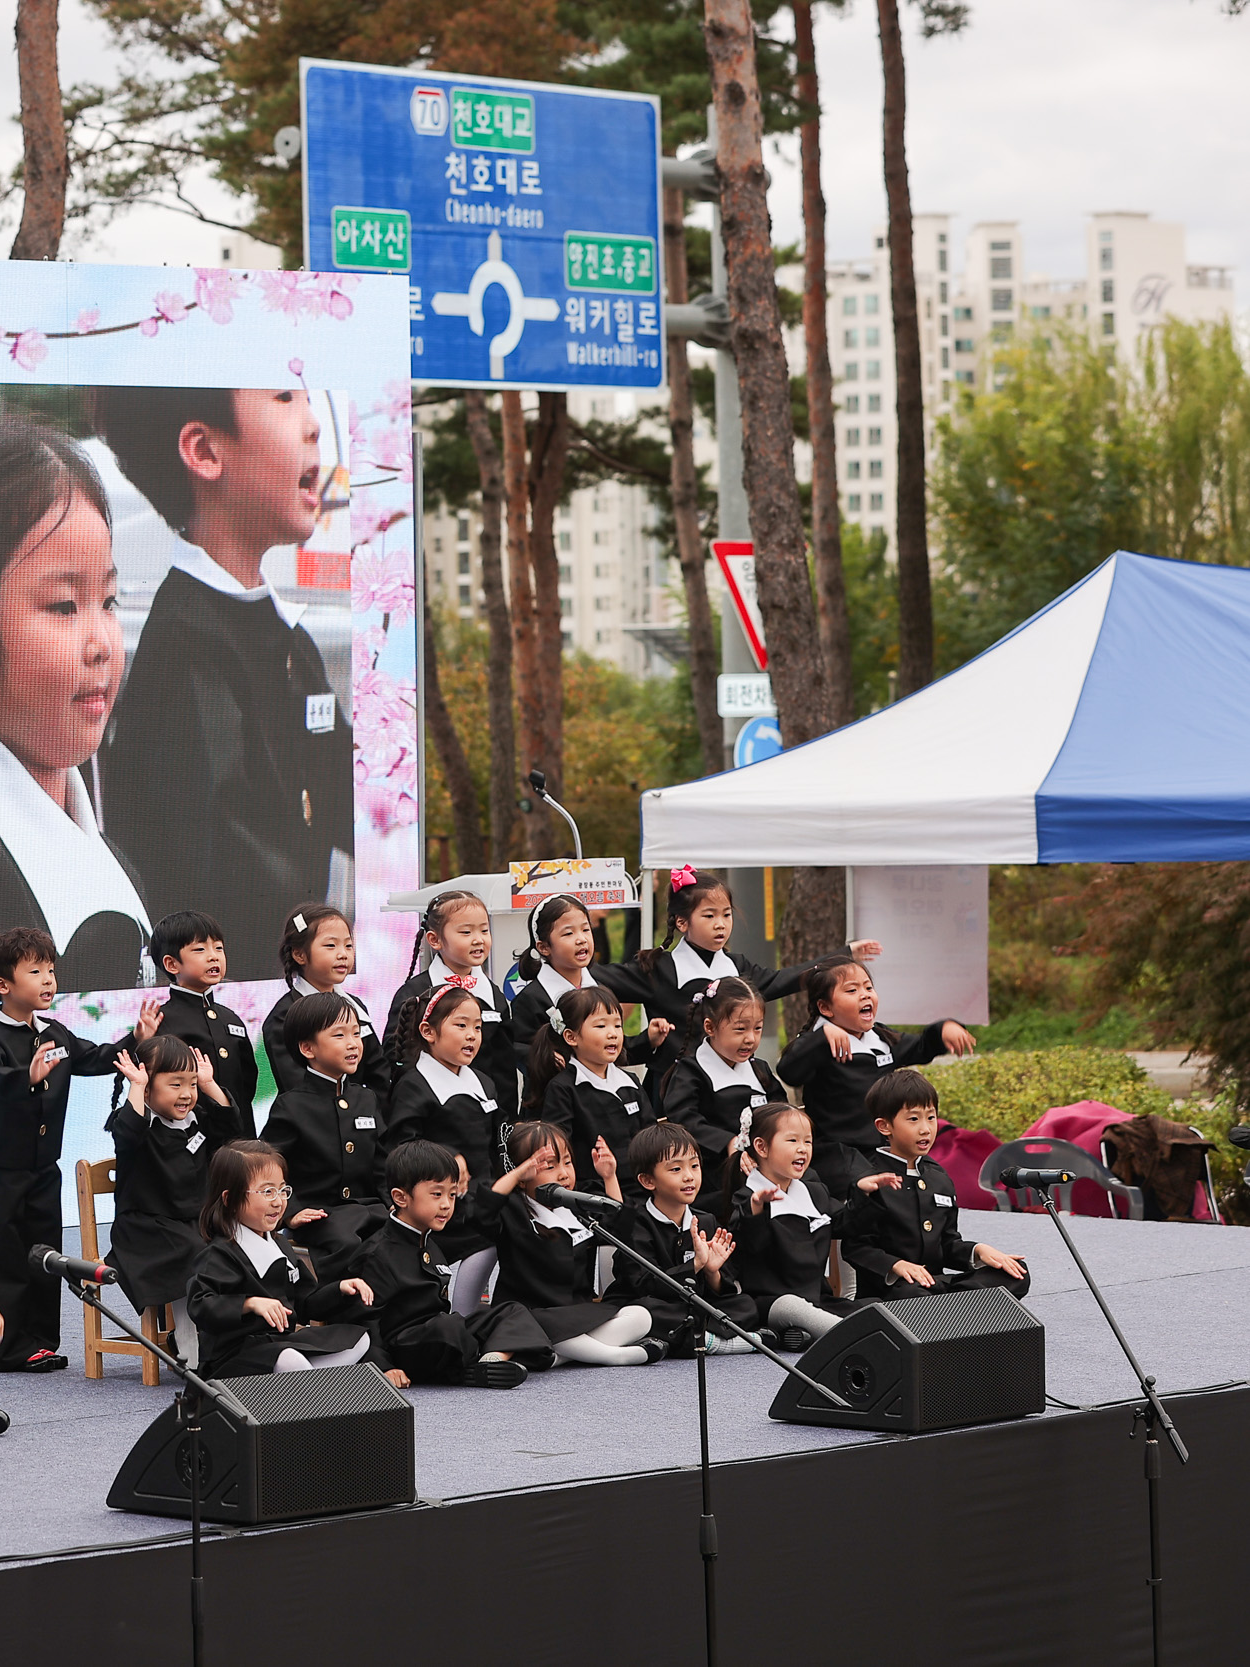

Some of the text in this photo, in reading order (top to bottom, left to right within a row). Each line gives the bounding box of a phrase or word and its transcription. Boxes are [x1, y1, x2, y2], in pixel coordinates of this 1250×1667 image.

[419, 98, 441, 126] 70
[444, 151, 543, 197] 천호대로
[445, 197, 544, 229] Cheonho-daero
[337, 218, 406, 261] 아차산
[564, 297, 659, 343] 워커힐로
[566, 342, 659, 369] Walkerhill-ro
